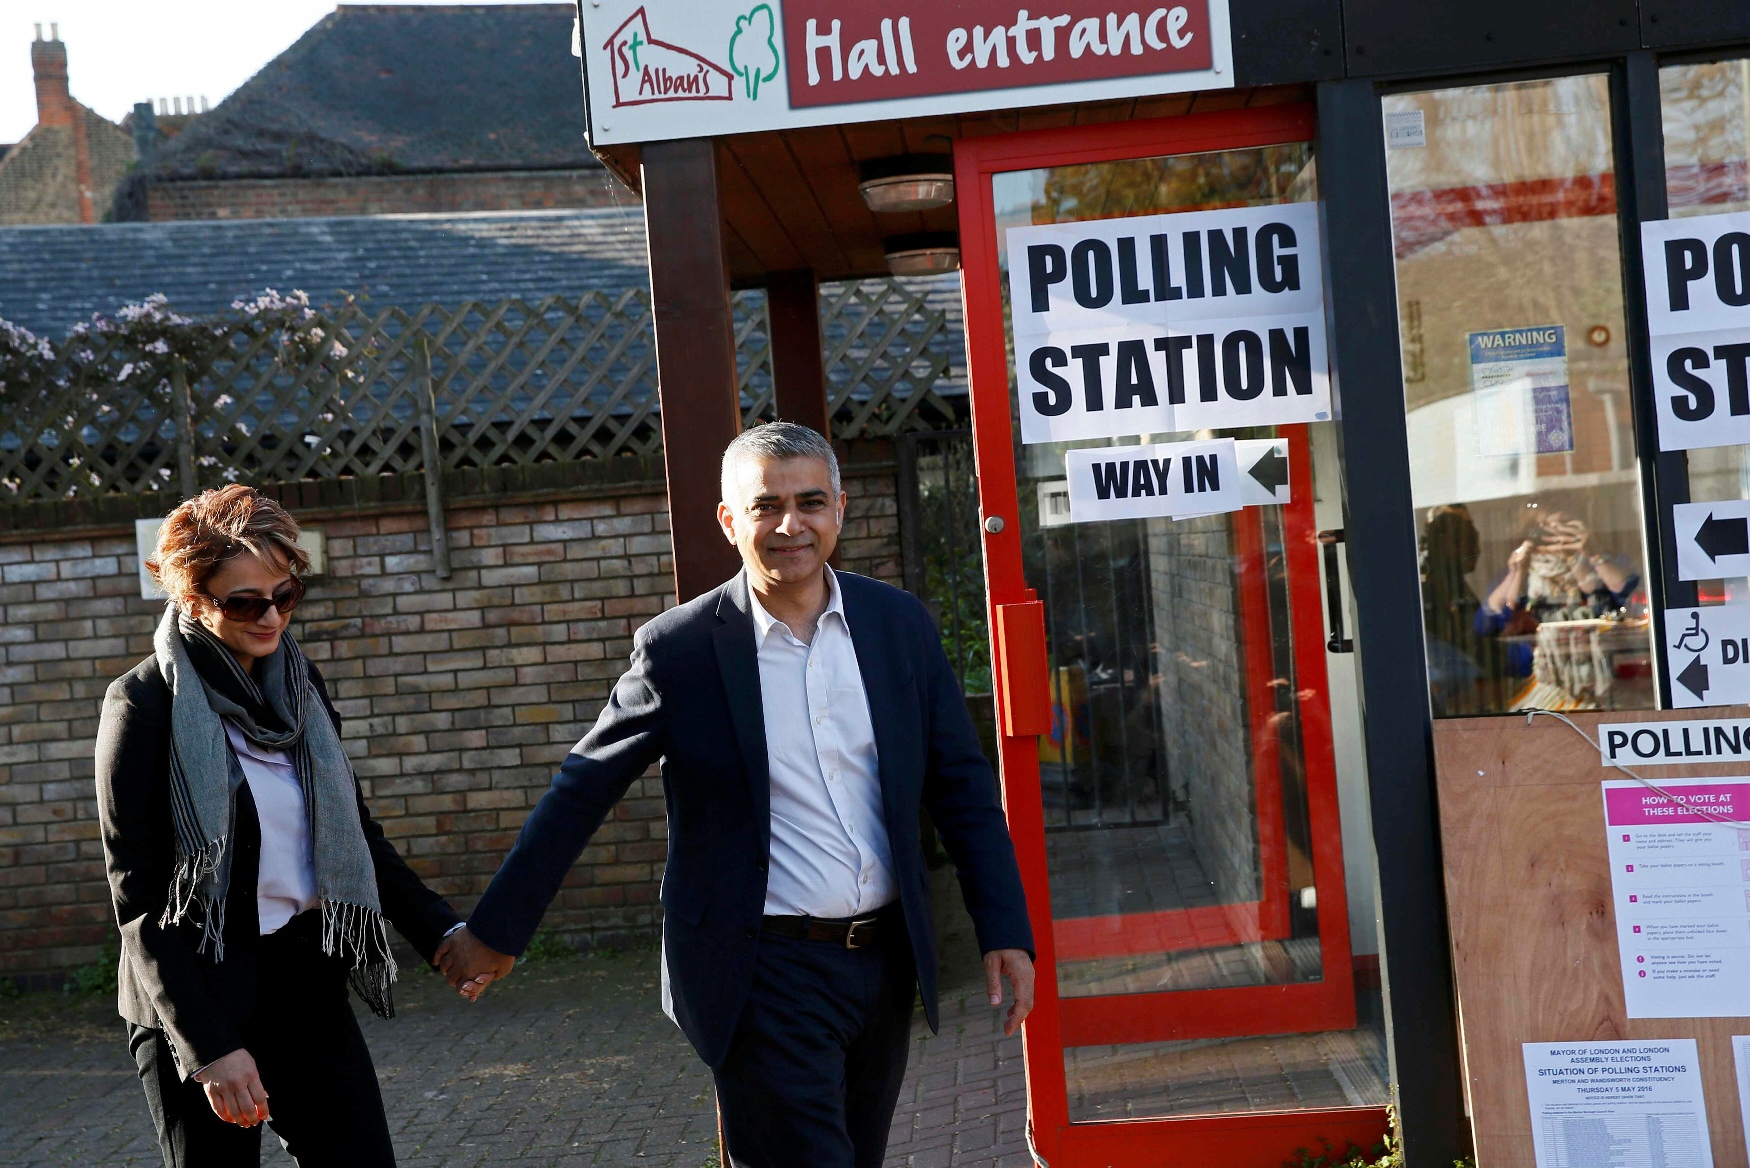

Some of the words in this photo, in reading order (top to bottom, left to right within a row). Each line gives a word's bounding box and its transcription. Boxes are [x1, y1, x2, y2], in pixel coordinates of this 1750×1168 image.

[617, 32, 644, 78] St
[805, 16, 917, 86] Hall
[946, 6, 1193, 70] entrance
[639, 64, 709, 95] Alban's
[1027, 222, 1300, 313] POLLING
[1478, 330, 1557, 348] WARNING
[1028, 326, 1312, 417] STATION
[1092, 458, 1172, 500] WAY
[1182, 454, 1220, 494] IN
[1721, 638, 1750, 664] DI
[1643, 807, 1674, 816] THESE
[1678, 805, 1733, 814] ELECTIONS
[1689, 794, 1716, 803] VOTE
[1538, 1068, 1585, 1076] SITUATION
